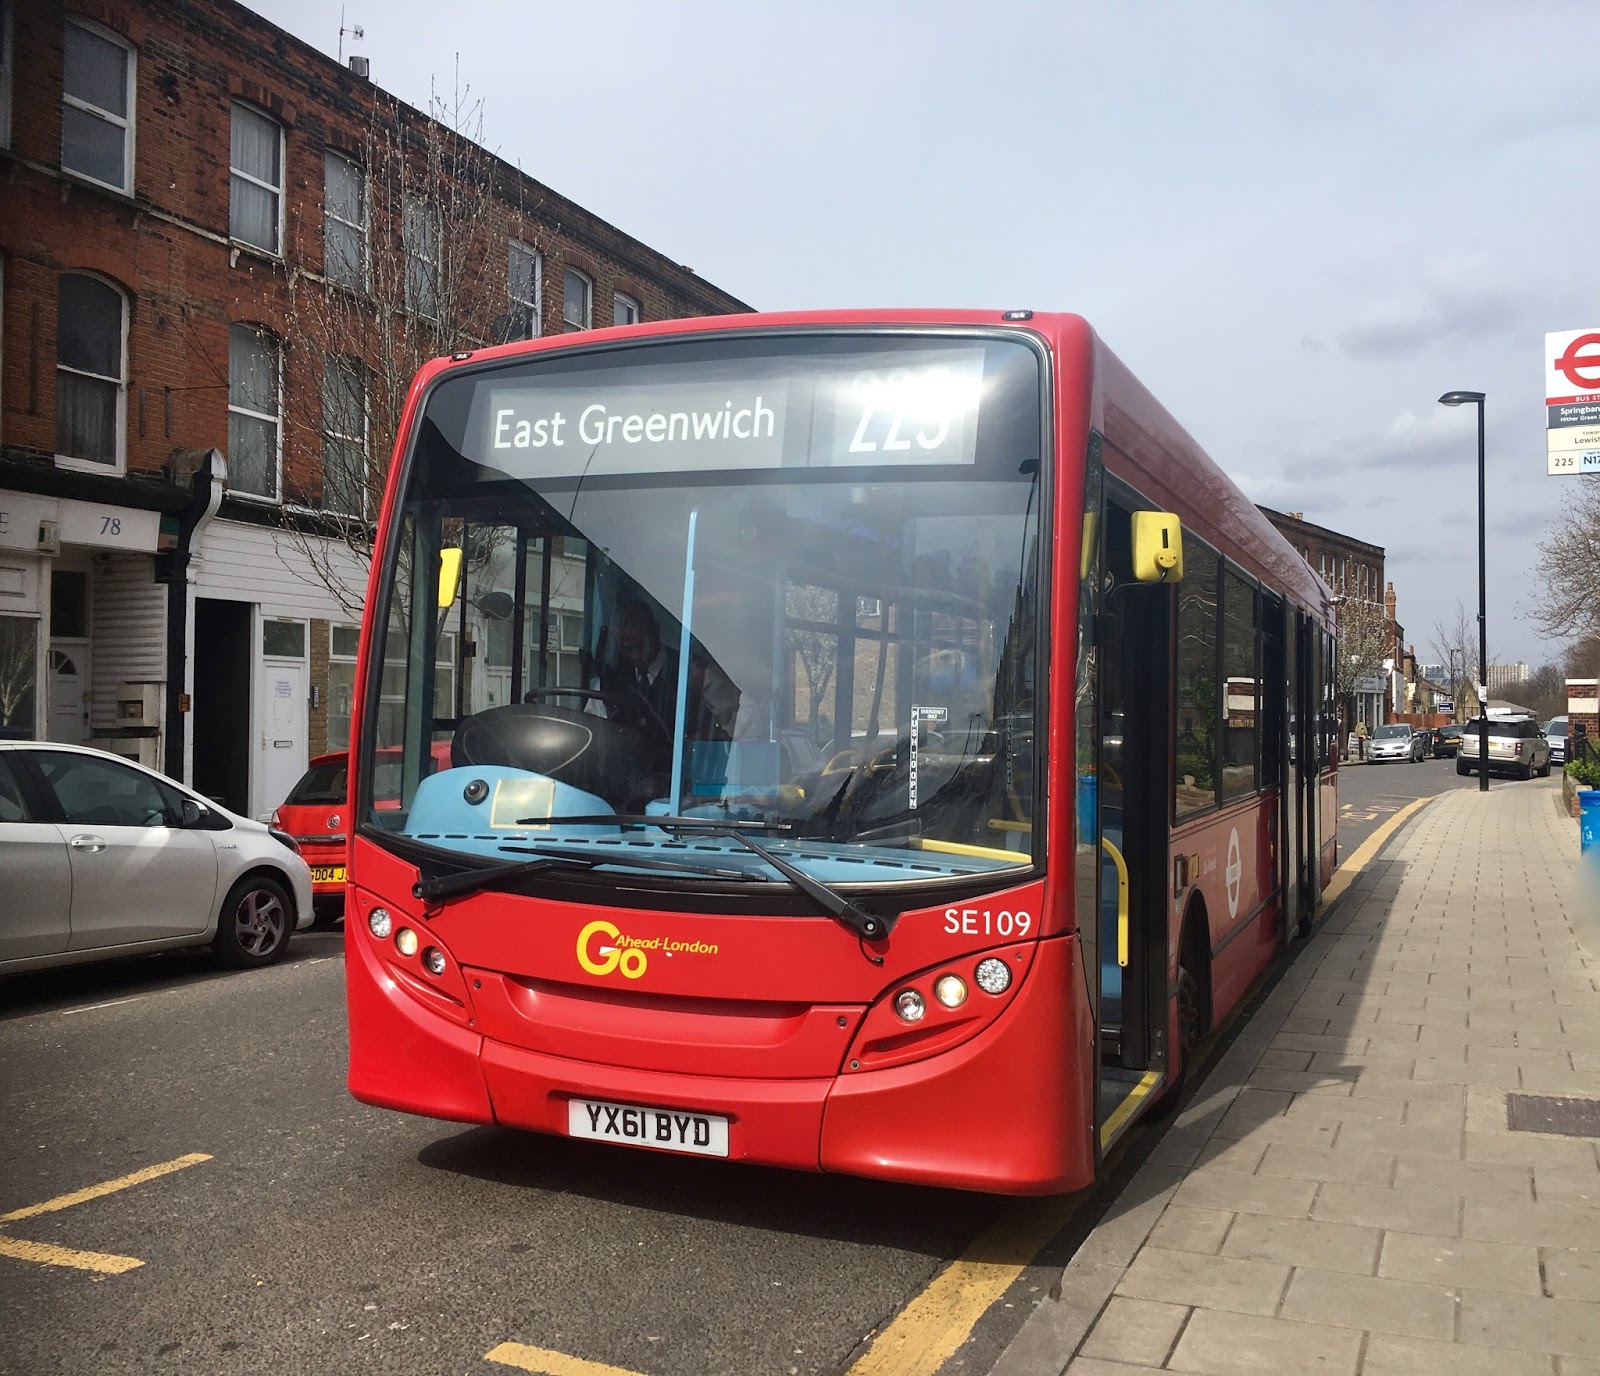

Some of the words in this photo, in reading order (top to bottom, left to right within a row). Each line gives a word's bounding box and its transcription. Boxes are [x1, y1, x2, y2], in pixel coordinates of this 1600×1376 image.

[494, 408, 565, 449] East
[578, 396, 775, 445] Greenwich
[1555, 458, 1573, 466] 225
[100, 516, 121, 536] 78
[911, 752, 917, 769] TO
[337, 868, 347, 881] J
[943, 908, 1031, 937] SE109
[576, 920, 648, 979] Go
[615, 935, 719, 954] Ahead-London
[586, 1104, 647, 1139] YX61
[655, 1112, 710, 1147] BYD
